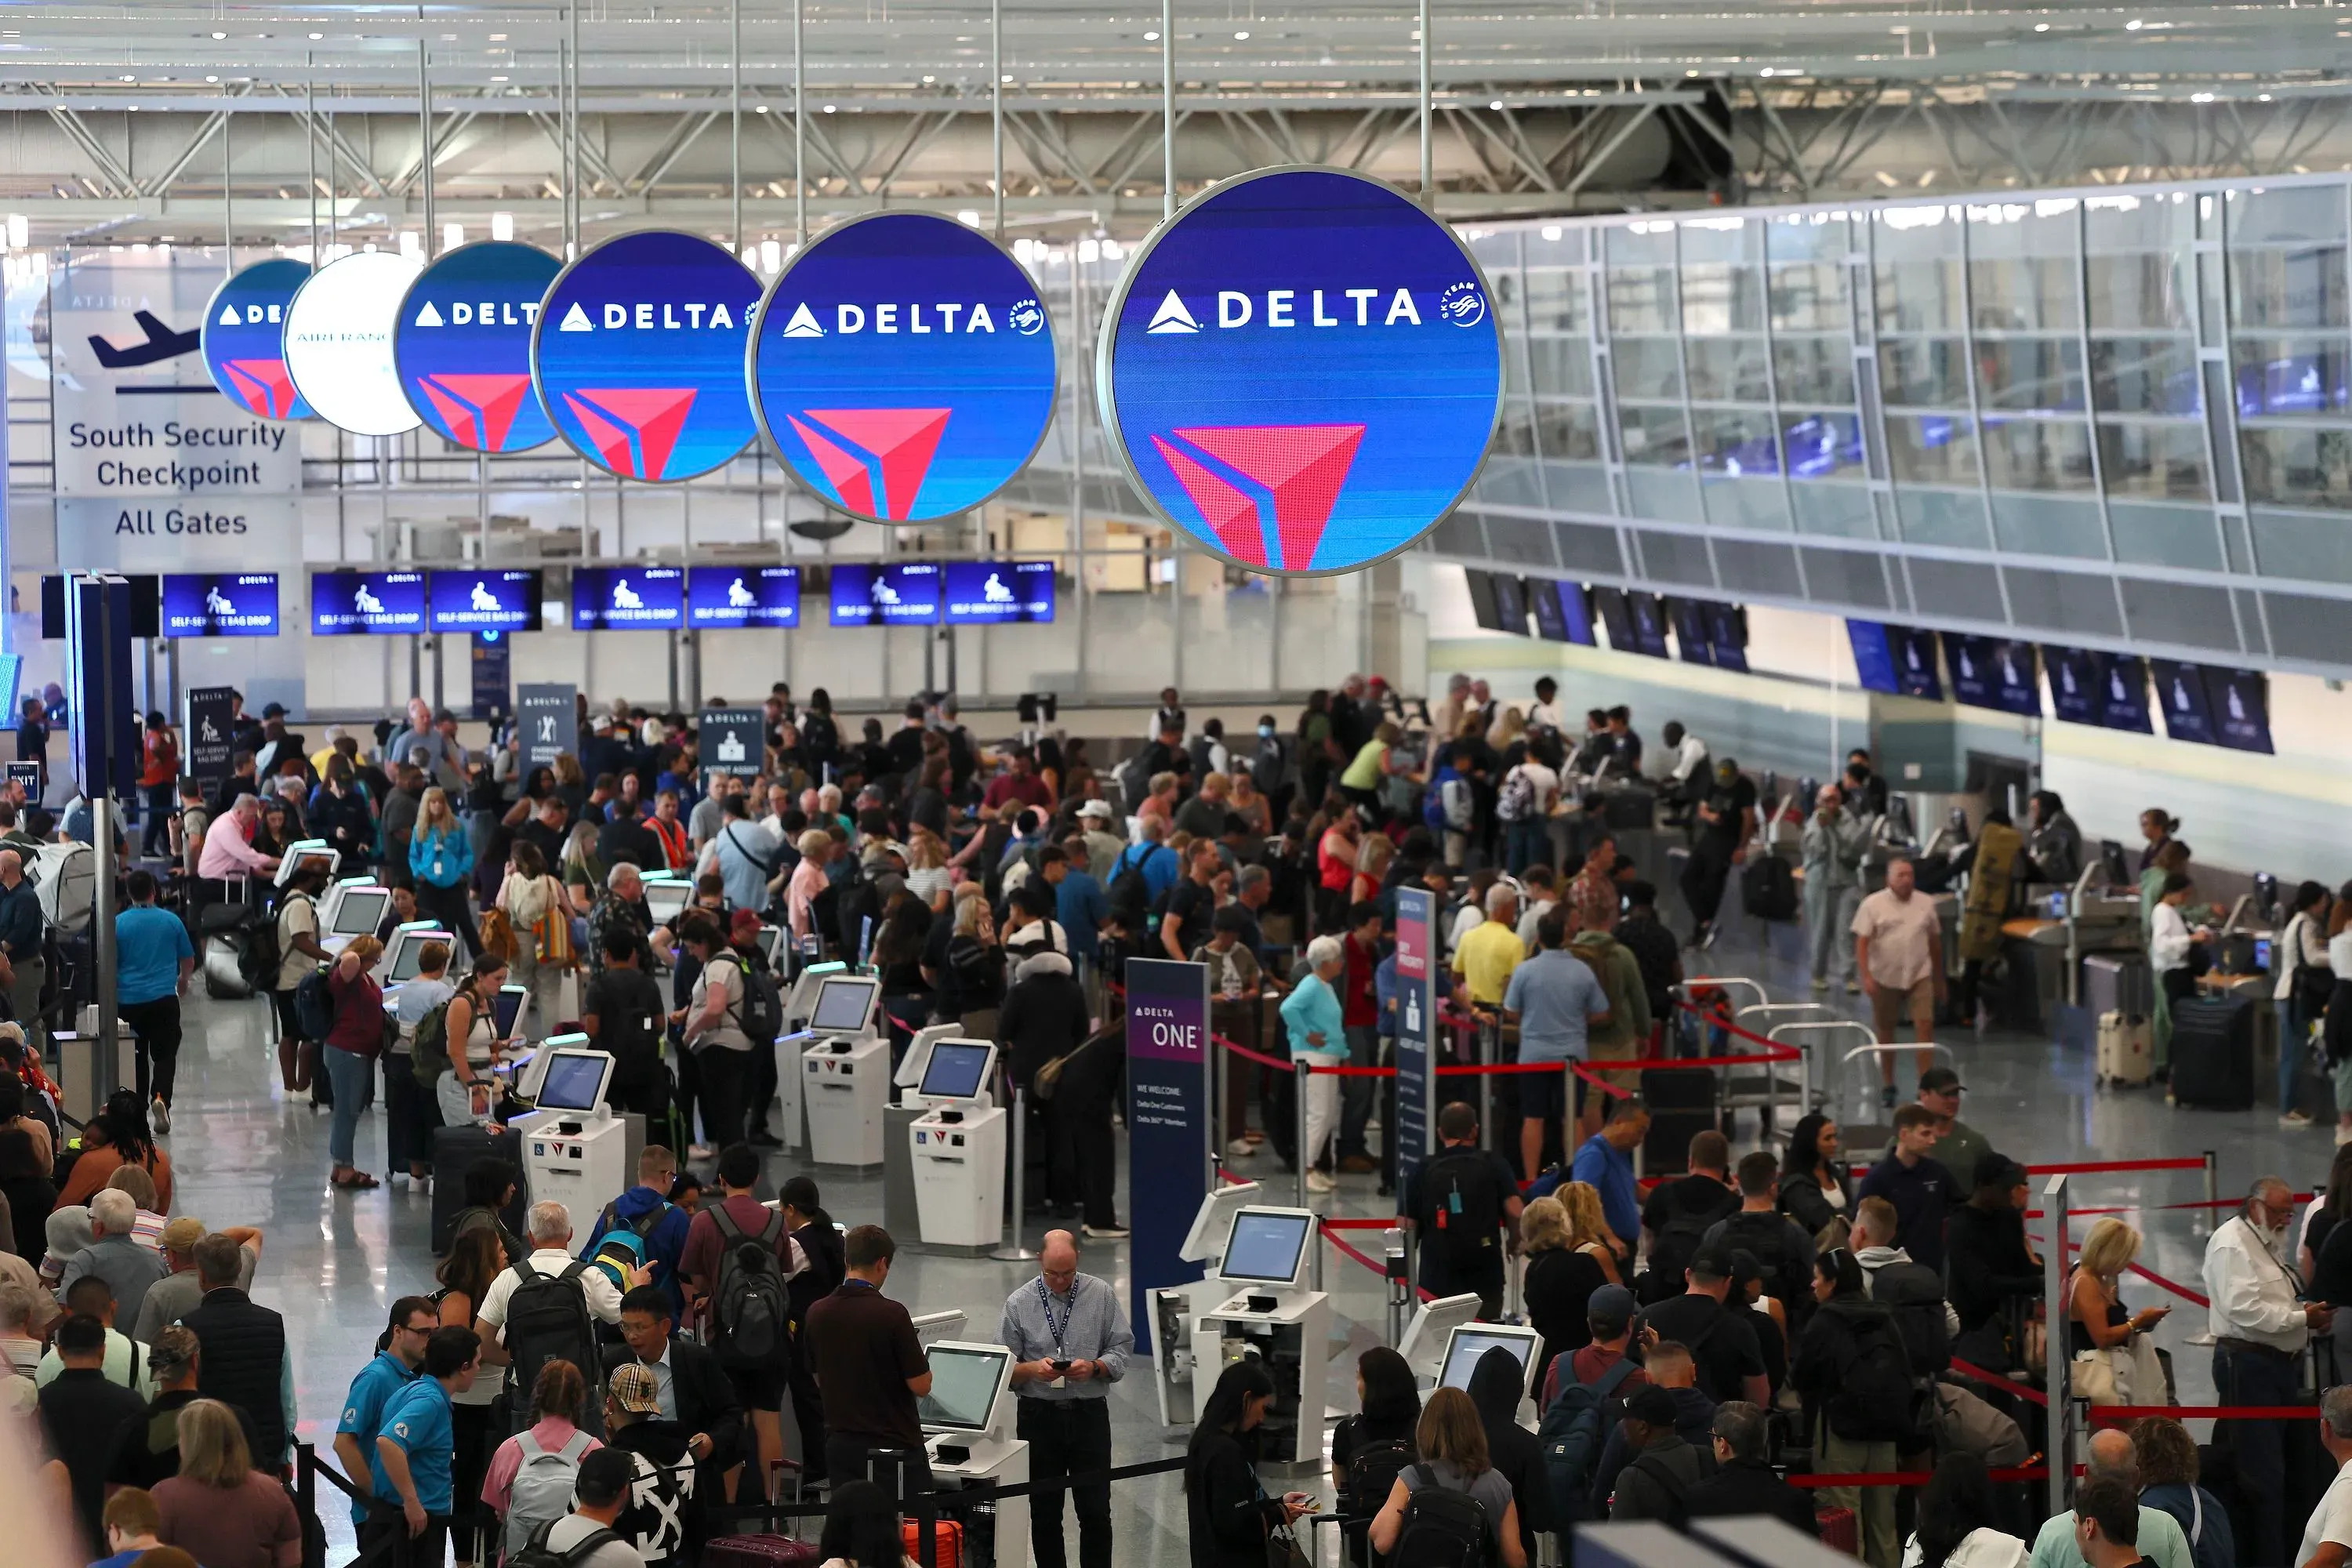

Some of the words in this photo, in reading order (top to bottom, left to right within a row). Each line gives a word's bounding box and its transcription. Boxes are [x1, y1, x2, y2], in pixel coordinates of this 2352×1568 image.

[452, 302, 539, 325] DELT
[1218, 288, 1422, 328] DELTA
[1440, 282, 1475, 319] SKYTEAM
[604, 303, 734, 329] DELTA
[837, 303, 996, 334] DELTA
[70, 423, 153, 447] South
[164, 421, 285, 452] Security
[97, 459, 260, 491] Checkpoint
[115, 510, 155, 535] All
[165, 510, 247, 535] Gates
[171, 616, 227, 627] SELF-SERCE
[247, 615, 272, 626] DROP
[1144, 1007, 1174, 1018] DELTA
[1152, 1022, 1197, 1049] ONE
[1136, 1084, 1148, 1093] WE
